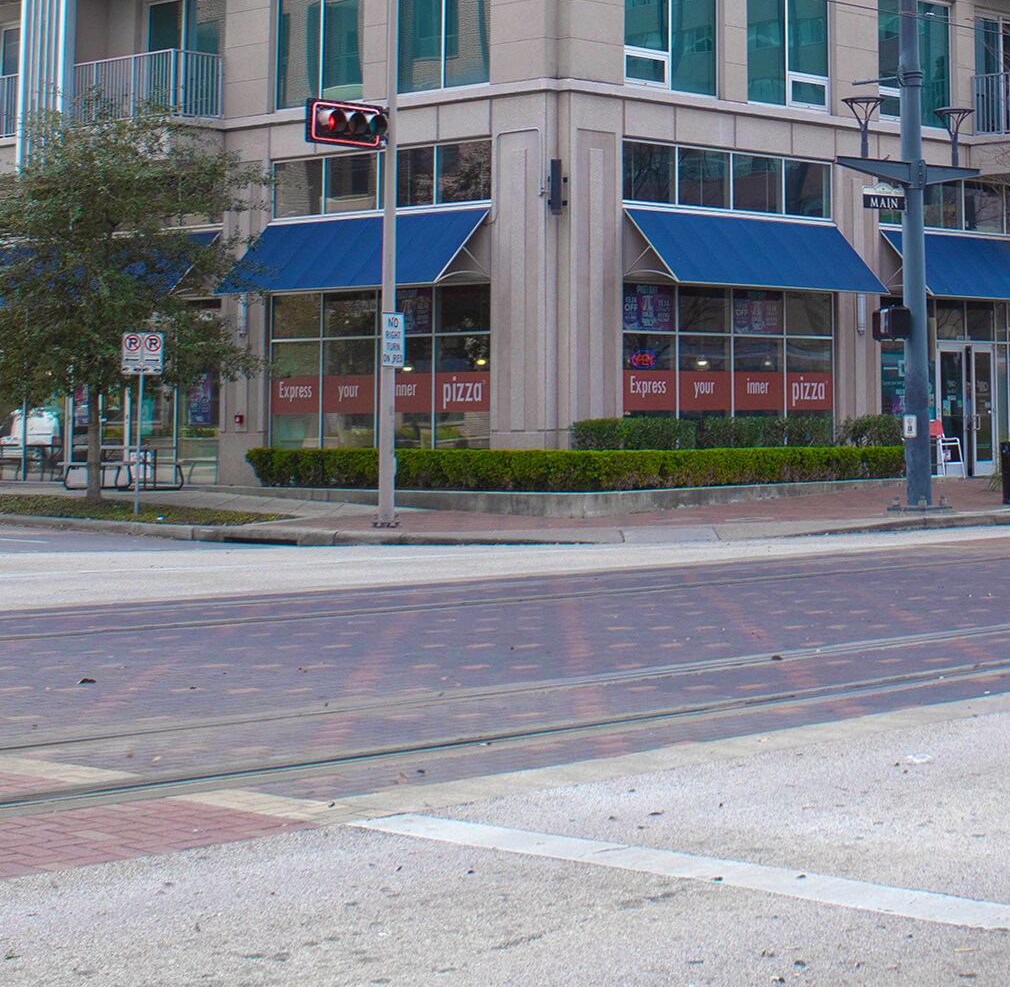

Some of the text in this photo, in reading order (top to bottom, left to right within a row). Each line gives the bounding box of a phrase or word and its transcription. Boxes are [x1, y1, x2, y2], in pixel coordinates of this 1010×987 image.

[870, 197, 899, 209] MAIN
[624, 303, 639, 312] OFF
[388, 316, 399, 328] NO
[385, 330, 401, 339] RIGHT
[387, 342, 401, 351] TURN
[383, 353, 403, 363] ON RED
[279, 376, 482, 409] Express your nner pizza
[630, 375, 825, 407] Express your inner pizza
